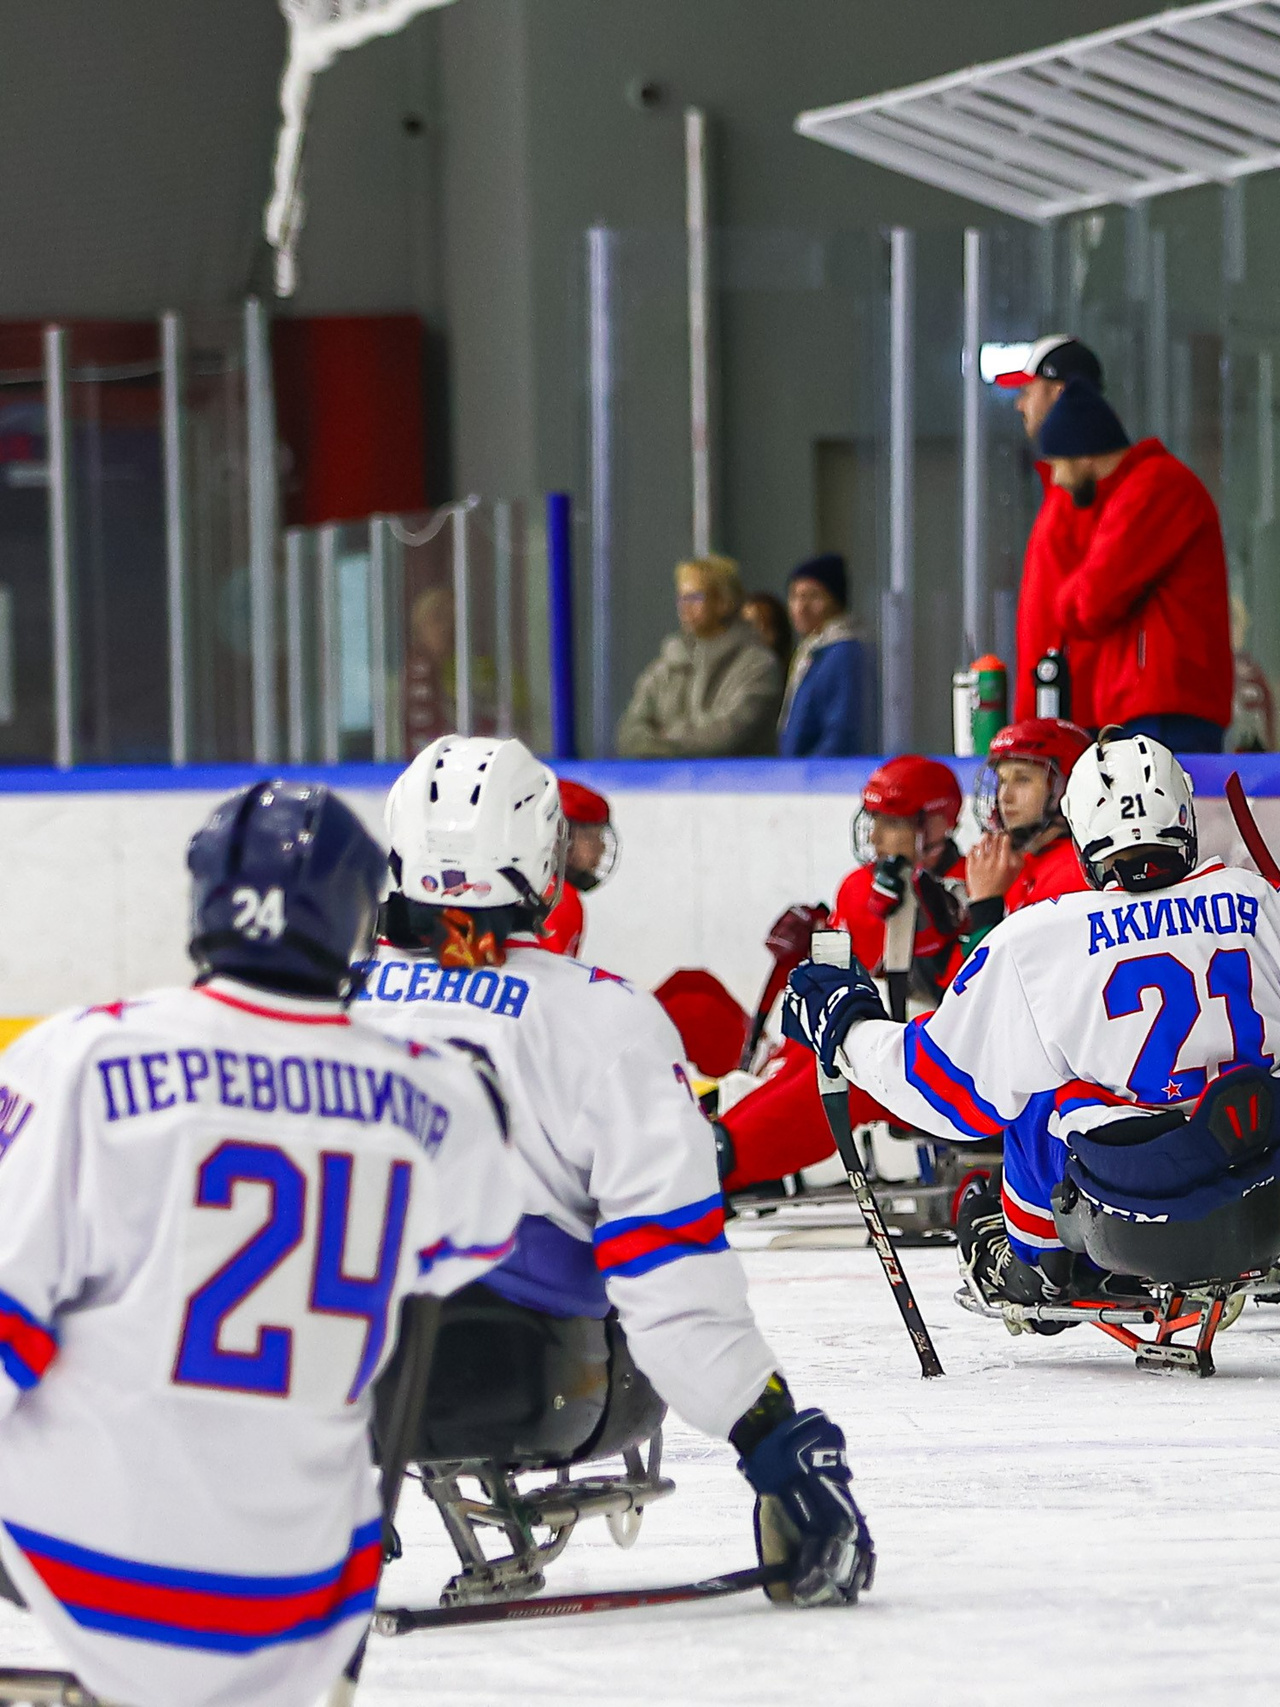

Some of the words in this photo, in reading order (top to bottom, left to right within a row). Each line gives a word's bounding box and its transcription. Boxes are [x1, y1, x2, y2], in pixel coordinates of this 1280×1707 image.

[1120, 793, 1147, 820] 21
[231, 885, 286, 940] 24
[1087, 892, 1259, 956] АКИМОВ
[1102, 947, 1275, 1105] 21
[171, 1138, 413, 1405] 24
